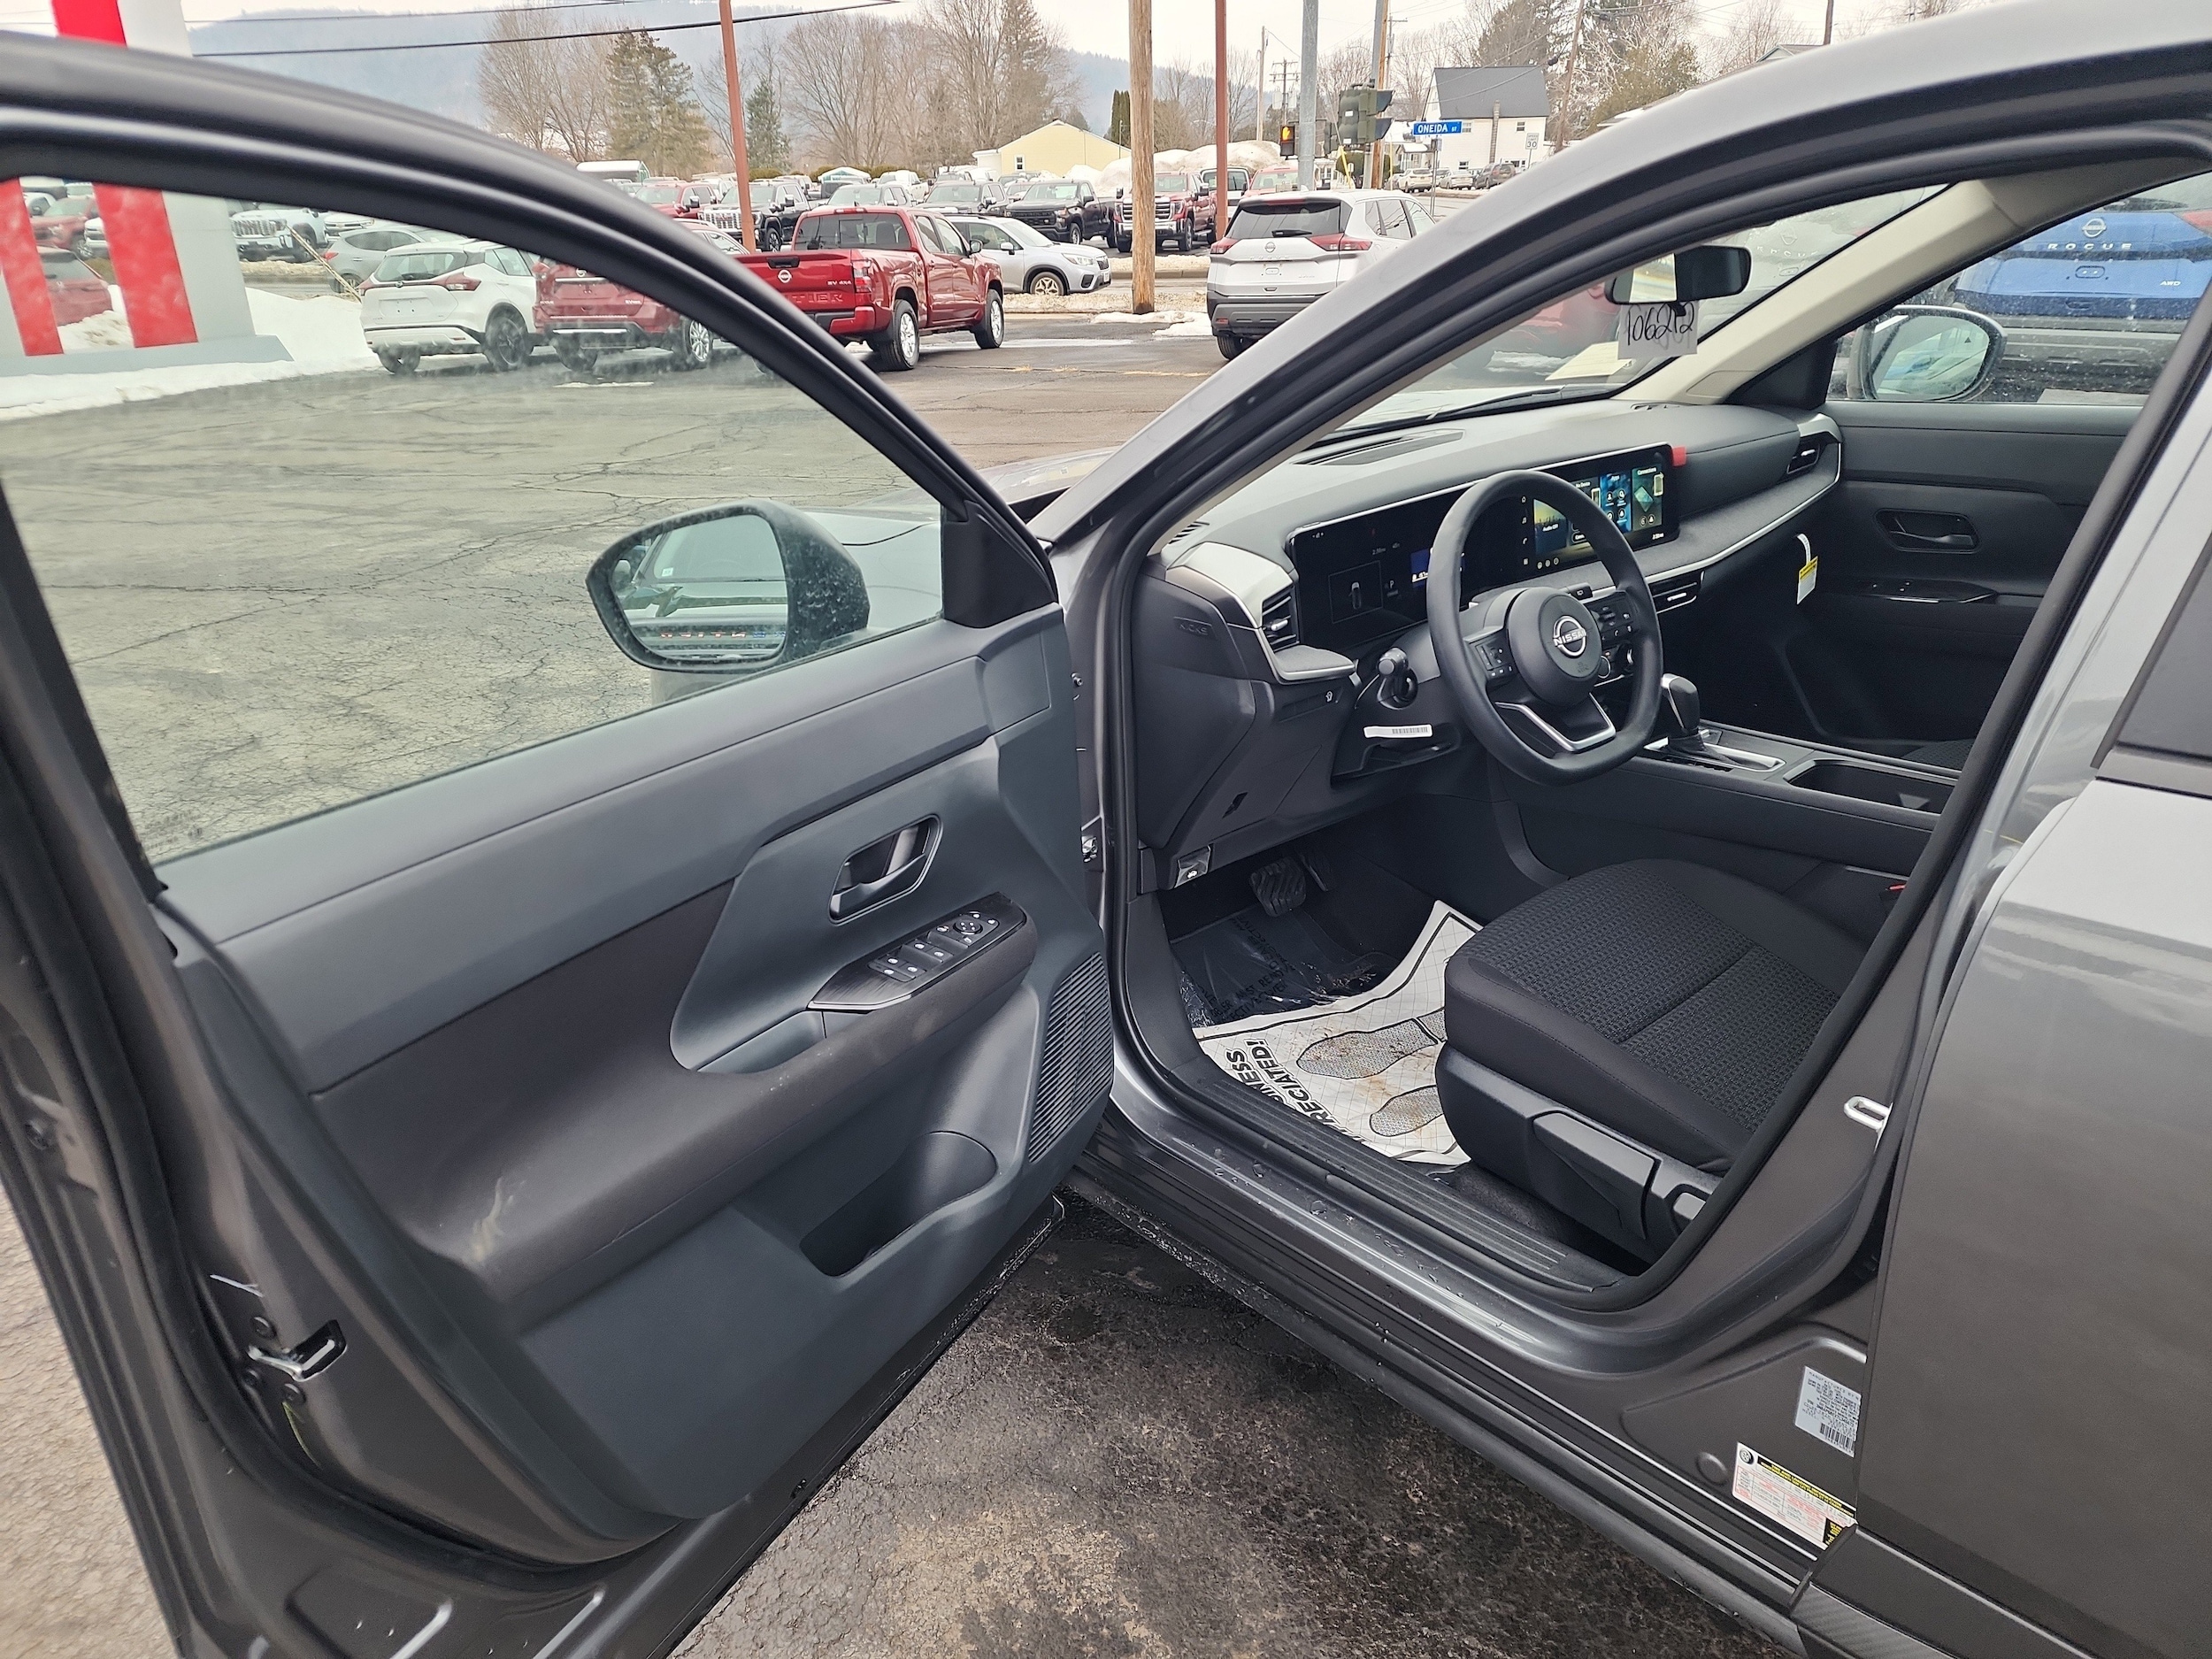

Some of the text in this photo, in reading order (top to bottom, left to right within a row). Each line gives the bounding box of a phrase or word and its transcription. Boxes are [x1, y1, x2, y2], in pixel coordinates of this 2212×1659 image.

[1417, 124, 1448, 133] ONEIDA
[786, 293, 844, 303] TIER
[1553, 626, 1587, 647] NISSAN
[1246, 1039, 1334, 1124] RECIATED!
